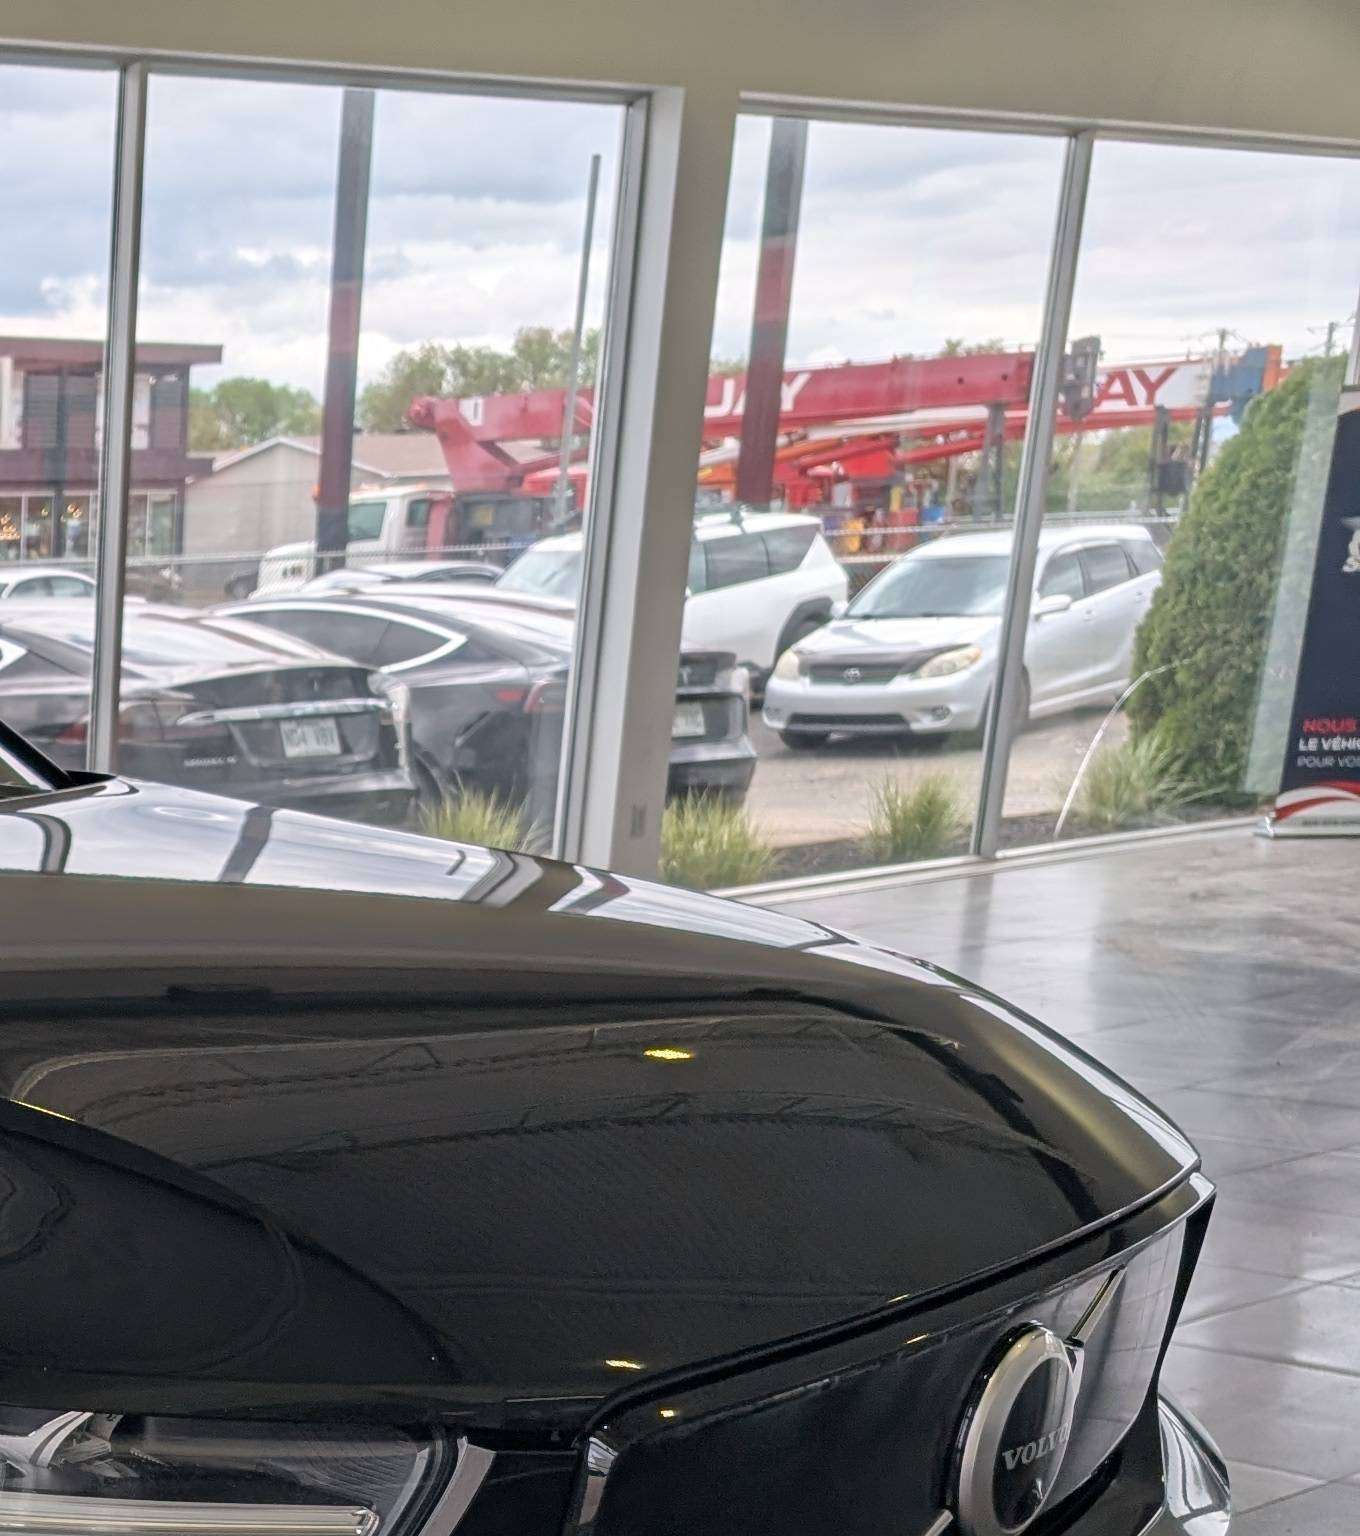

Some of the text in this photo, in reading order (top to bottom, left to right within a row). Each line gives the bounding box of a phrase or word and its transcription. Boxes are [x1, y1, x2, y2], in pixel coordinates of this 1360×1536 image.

[1303, 717, 1357, 733] NOUS
[1298, 737, 1318, 751] LE
[1002, 1422, 1069, 1471] VOLVO
